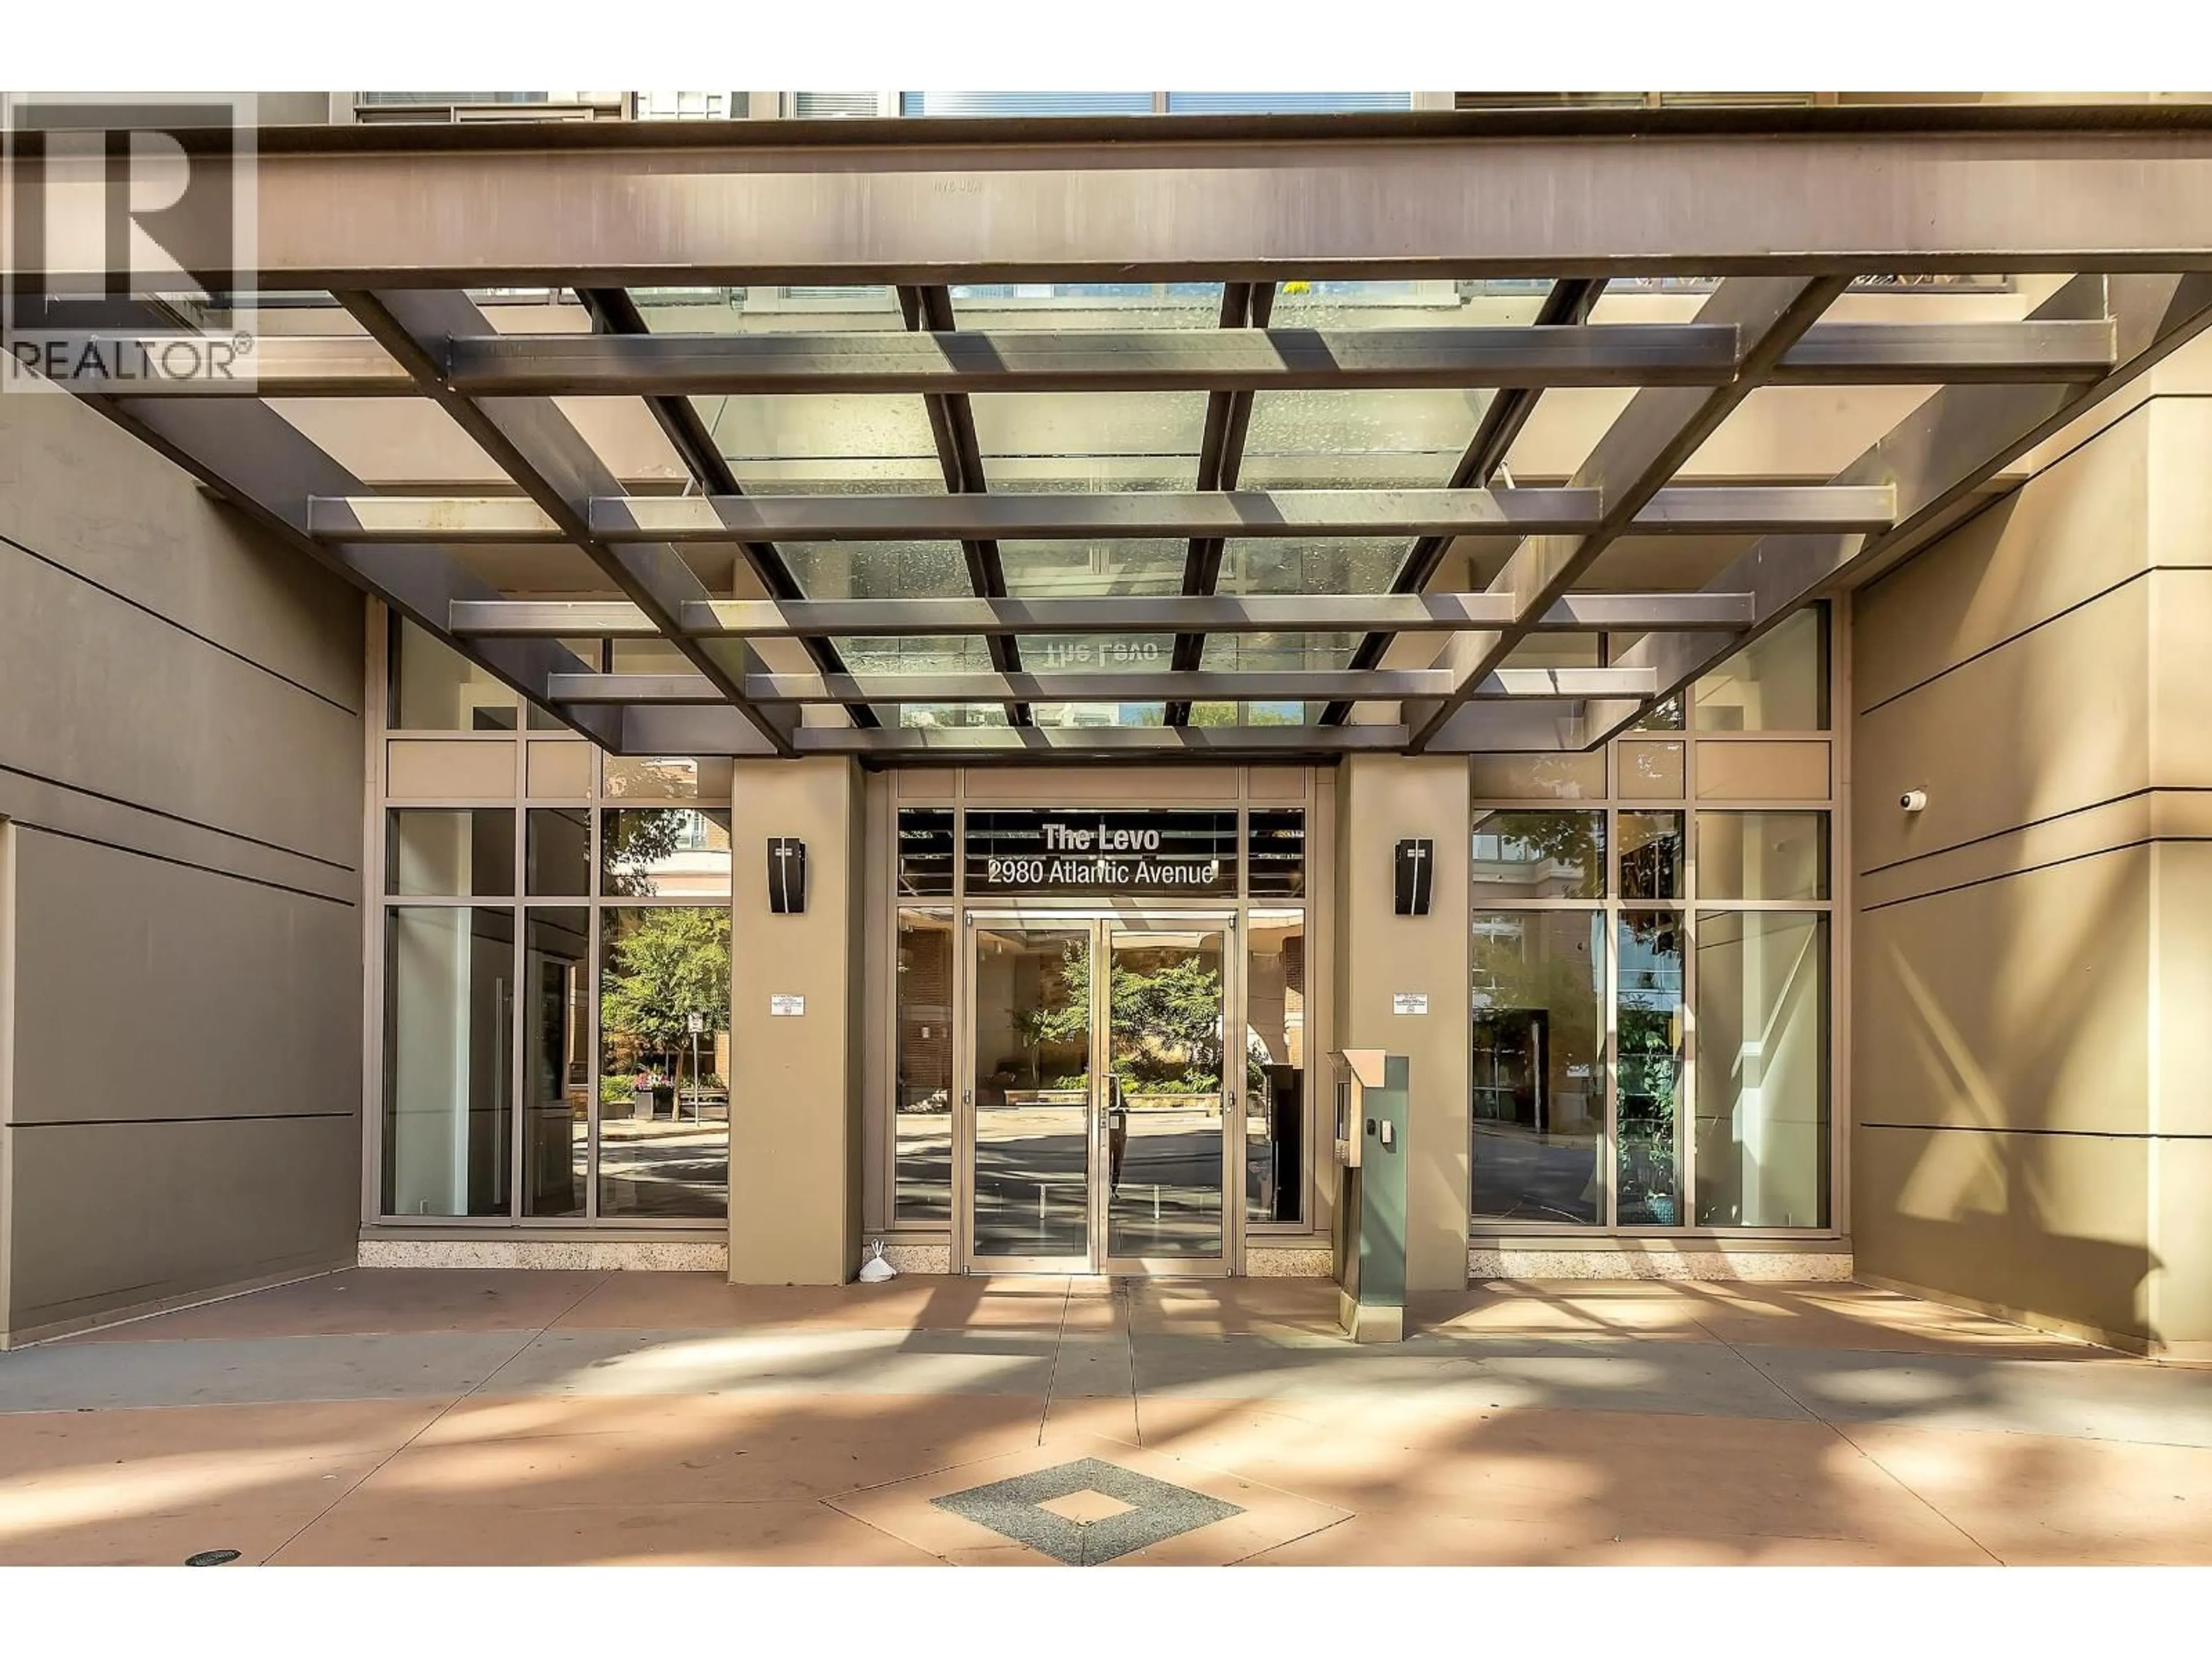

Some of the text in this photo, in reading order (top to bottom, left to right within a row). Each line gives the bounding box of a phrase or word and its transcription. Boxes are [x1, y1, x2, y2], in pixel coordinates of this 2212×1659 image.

[1043, 824, 1160, 850] The Levo
[988, 860, 1214, 884] 2980 Atlantic Avenue
